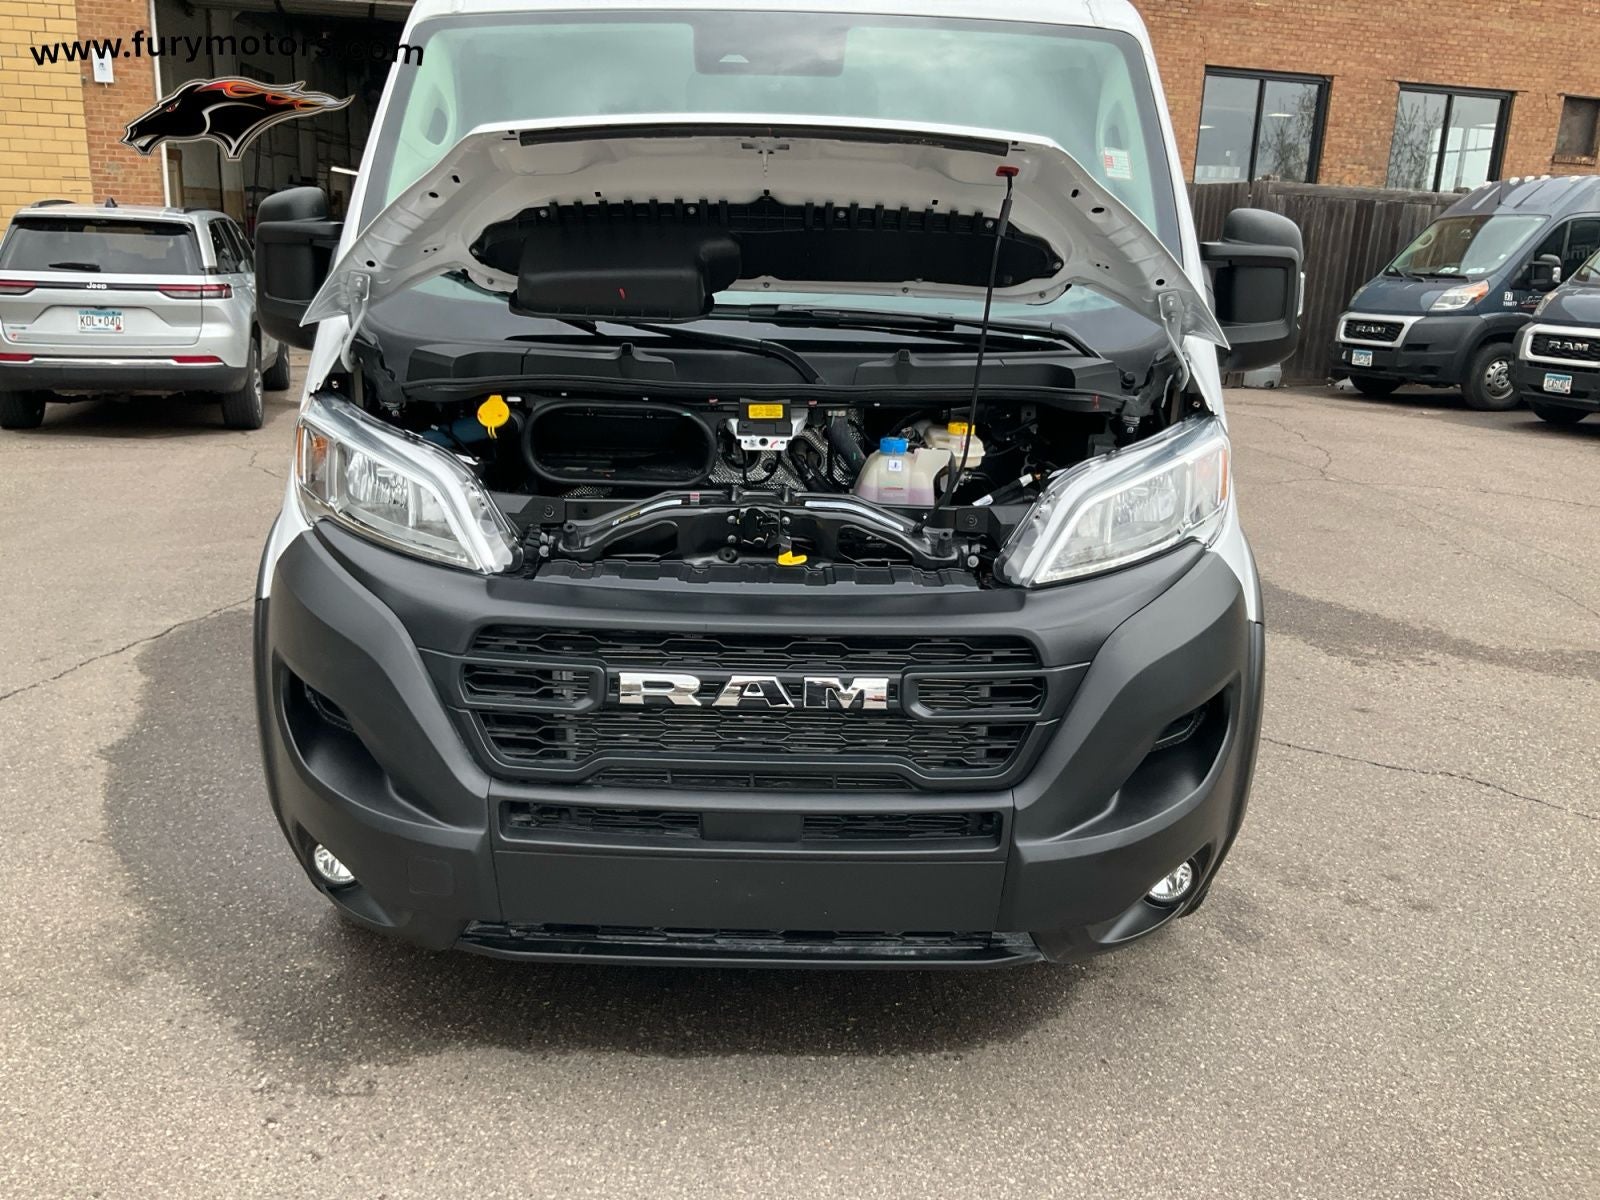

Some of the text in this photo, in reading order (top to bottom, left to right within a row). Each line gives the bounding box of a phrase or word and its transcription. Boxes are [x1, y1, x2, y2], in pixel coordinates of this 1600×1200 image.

[86, 281, 107, 289] Jeep
[1355, 325, 1386, 334] RAM
[1548, 340, 1590, 351] RAM
[618, 672, 889, 710] RAM
